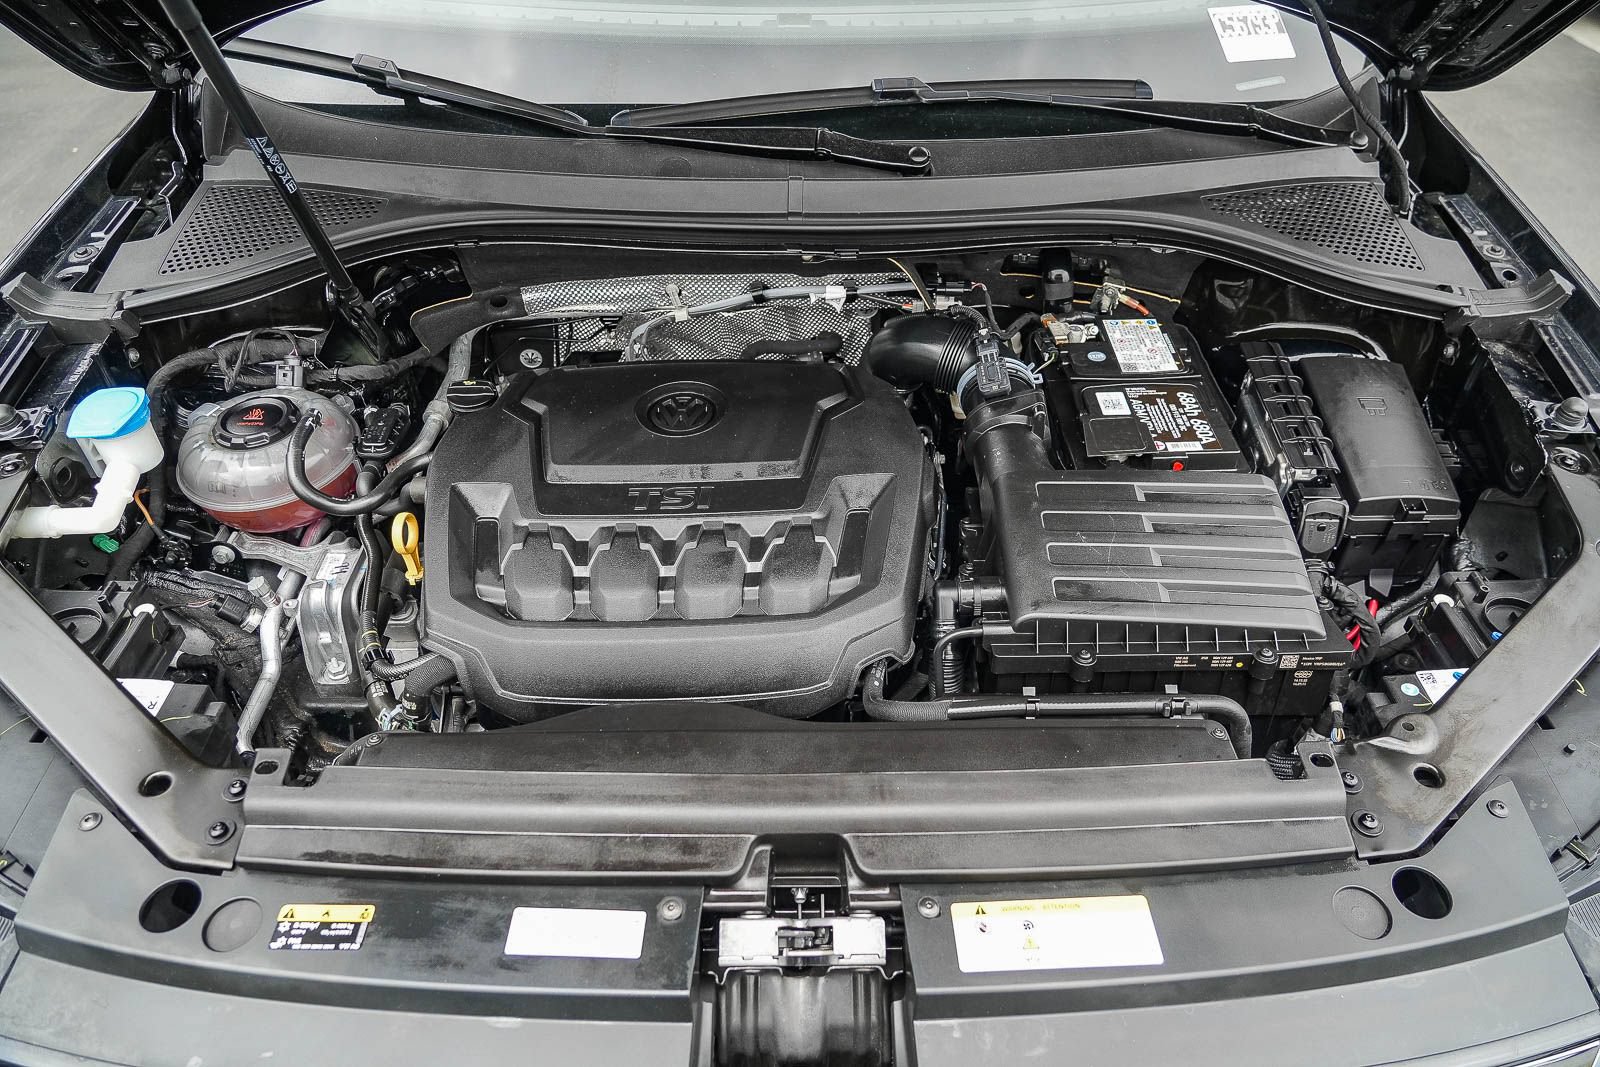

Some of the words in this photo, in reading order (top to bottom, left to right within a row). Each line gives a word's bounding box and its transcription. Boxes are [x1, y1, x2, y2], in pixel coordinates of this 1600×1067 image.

[648, 392, 717, 432] VW
[1176, 391, 1202, 417] 68Ah
[1189, 418, 1217, 444] 680A
[628, 486, 715, 511] TSI
